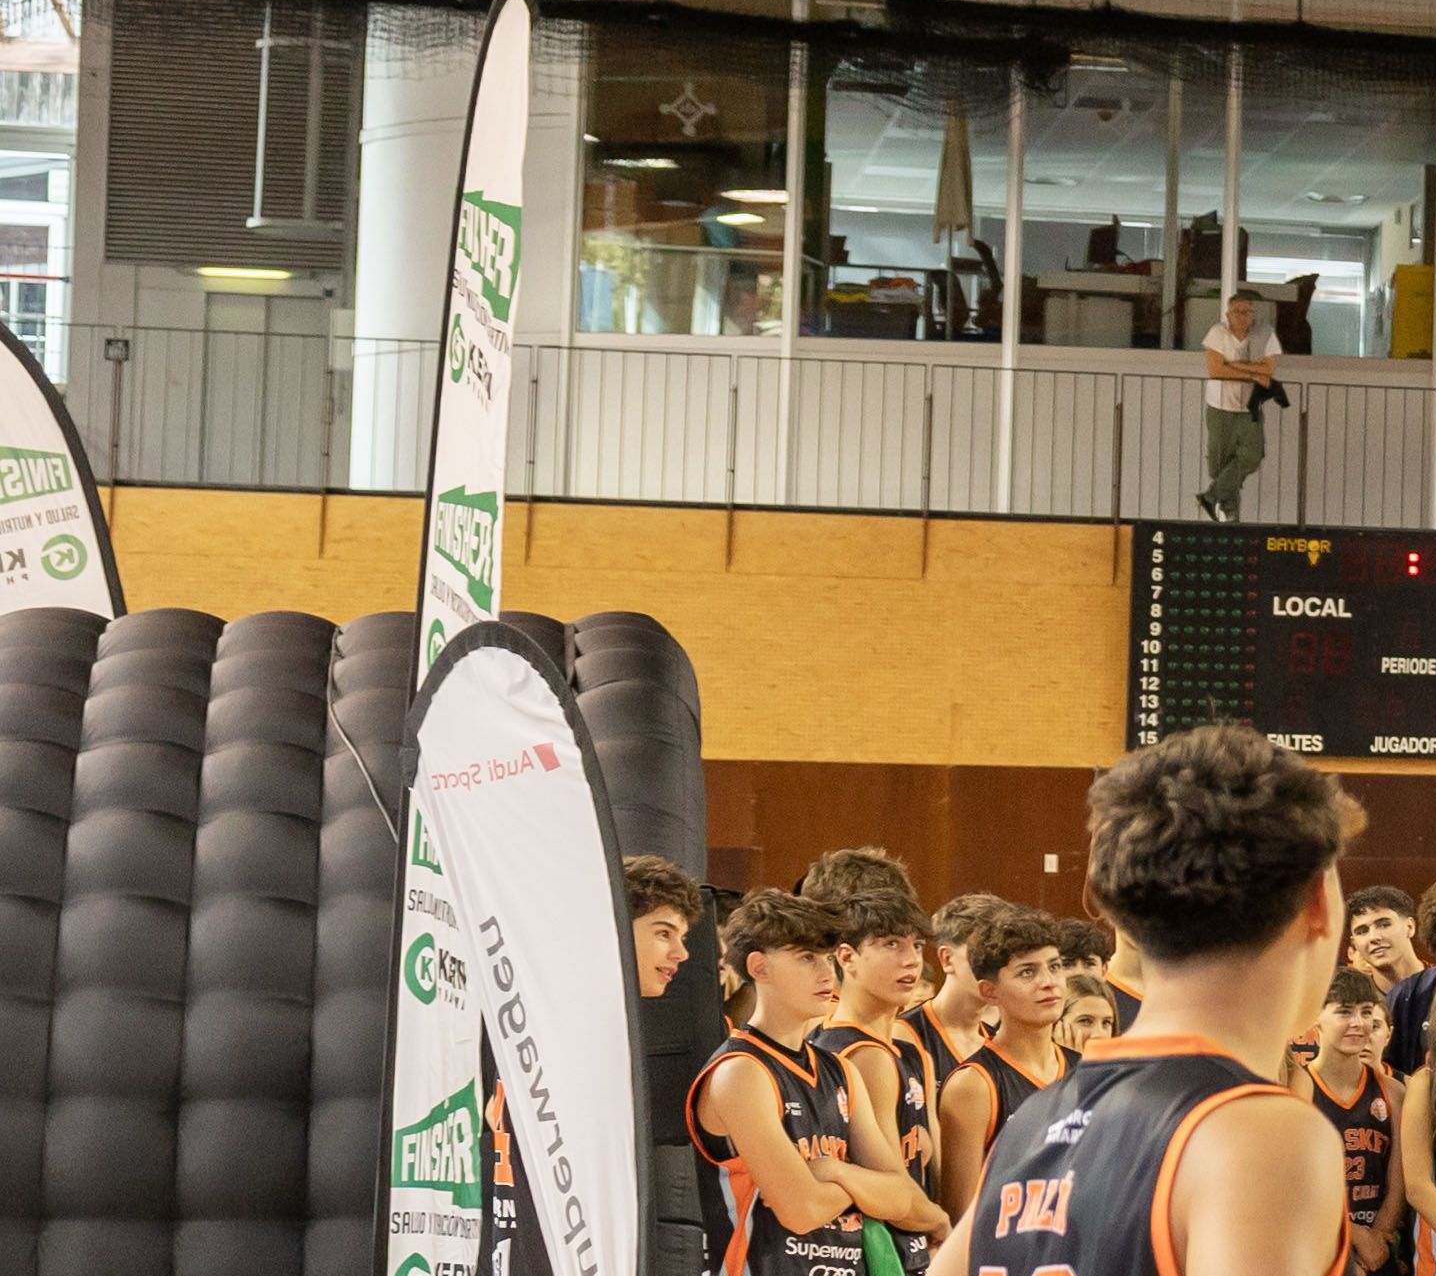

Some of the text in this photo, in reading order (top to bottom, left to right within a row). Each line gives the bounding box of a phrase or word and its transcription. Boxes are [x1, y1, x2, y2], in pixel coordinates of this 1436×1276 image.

[1152, 531, 1163, 545] 4
[1152, 550, 1163, 563] 5
[1152, 568, 1163, 581] 6
[1151, 586, 1163, 599] 7
[1151, 604, 1162, 618] 8
[1272, 595, 1352, 618] LOCAL
[1150, 622, 1161, 636] 9
[1141, 641, 1161, 655] 10
[1141, 659, 1160, 673] 11
[1380, 657, 1436, 676] PERIODE
[1141, 677, 1160, 691] 12
[1140, 695, 1160, 709] 13
[1140, 713, 1160, 727] 14
[1139, 731, 1157, 745] 15
[1267, 733, 1323, 752] FALTES
